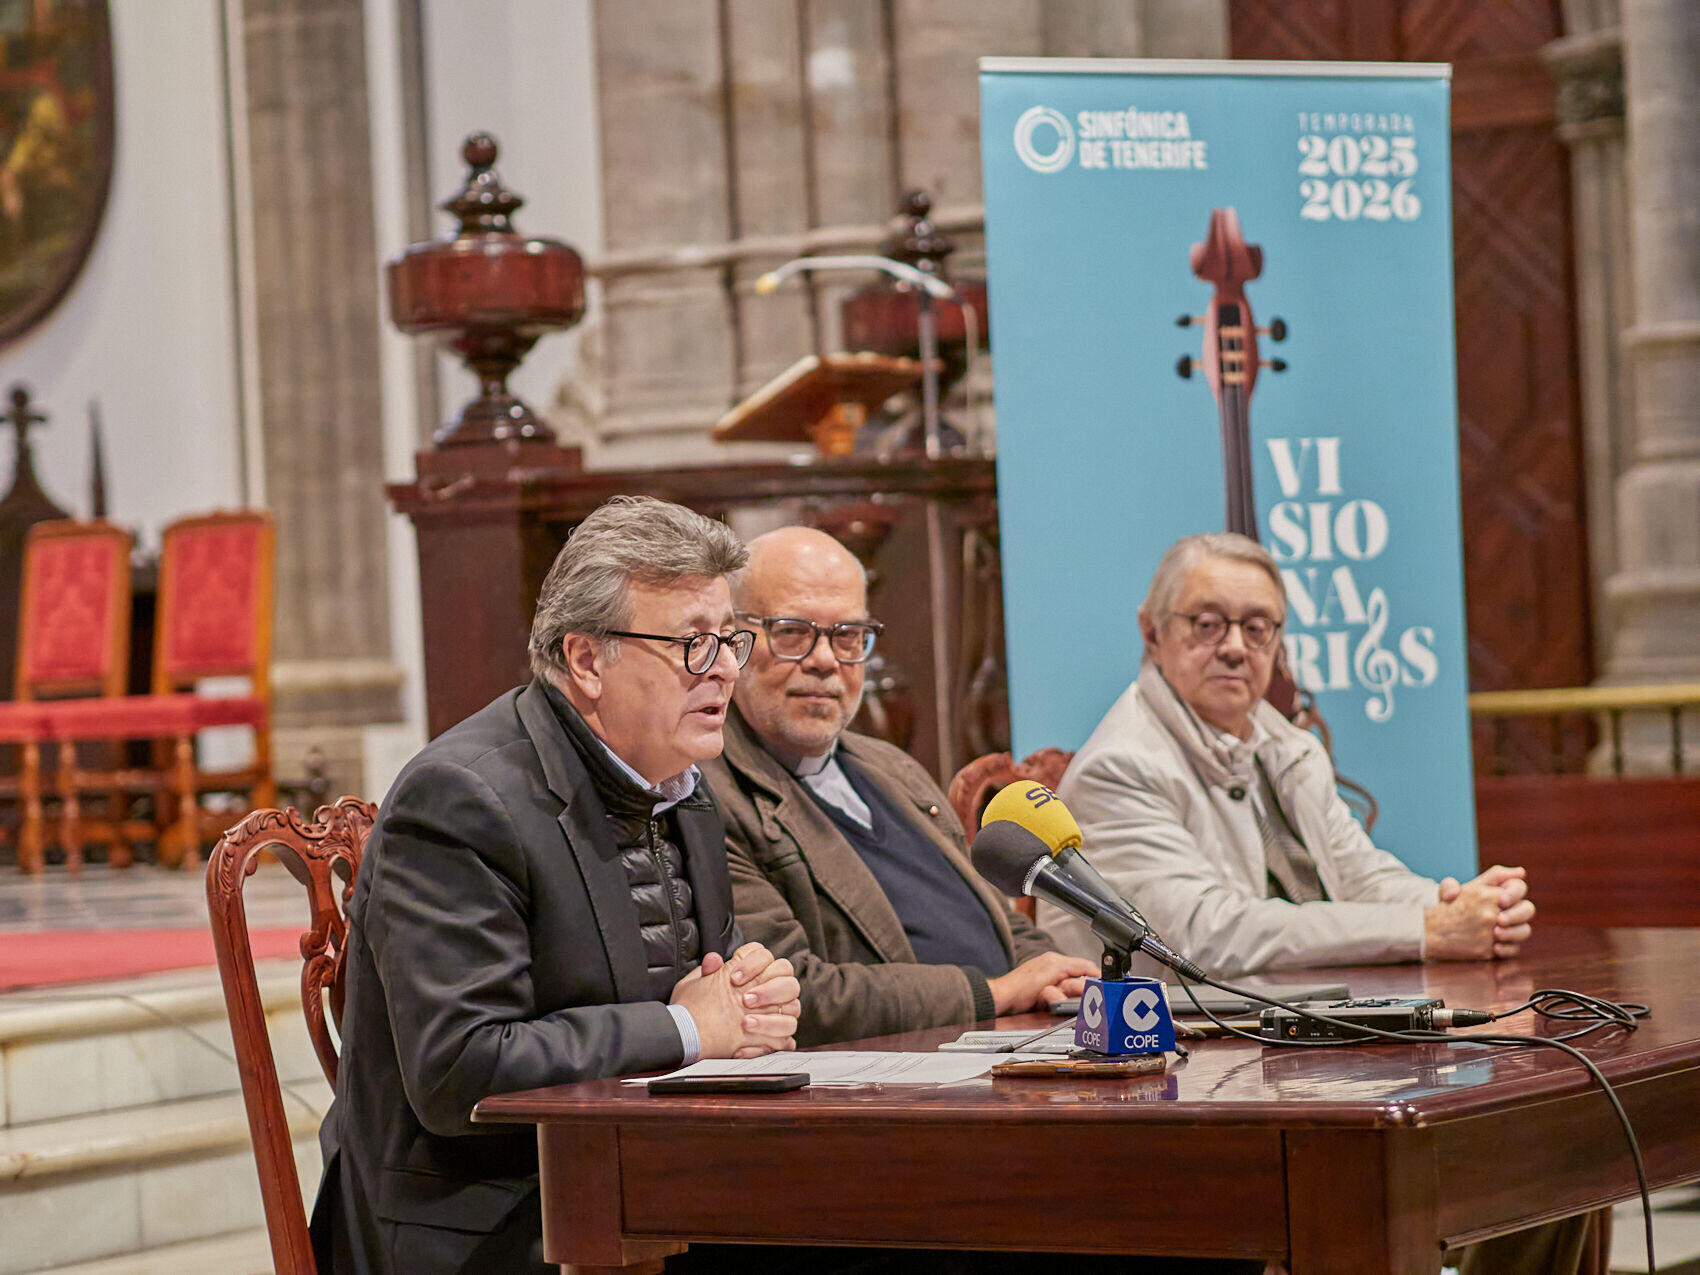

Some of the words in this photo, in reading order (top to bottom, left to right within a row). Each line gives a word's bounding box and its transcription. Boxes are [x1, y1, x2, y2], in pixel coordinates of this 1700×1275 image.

[1077, 106, 1191, 139] SINFÓNICA
[1299, 112, 1414, 132] TEMPORADA
[1079, 140, 1109, 168] DE
[1109, 140, 1208, 169] TENERIFE
[1298, 134, 1419, 177] 2025
[1299, 179, 1421, 221] 2026
[1267, 437, 1342, 497] VI
[1269, 500, 1389, 561] SIO
[1280, 566, 1367, 627] NA
[1082, 1030, 1101, 1047] COPE
[1124, 1034, 1159, 1049] COPE
